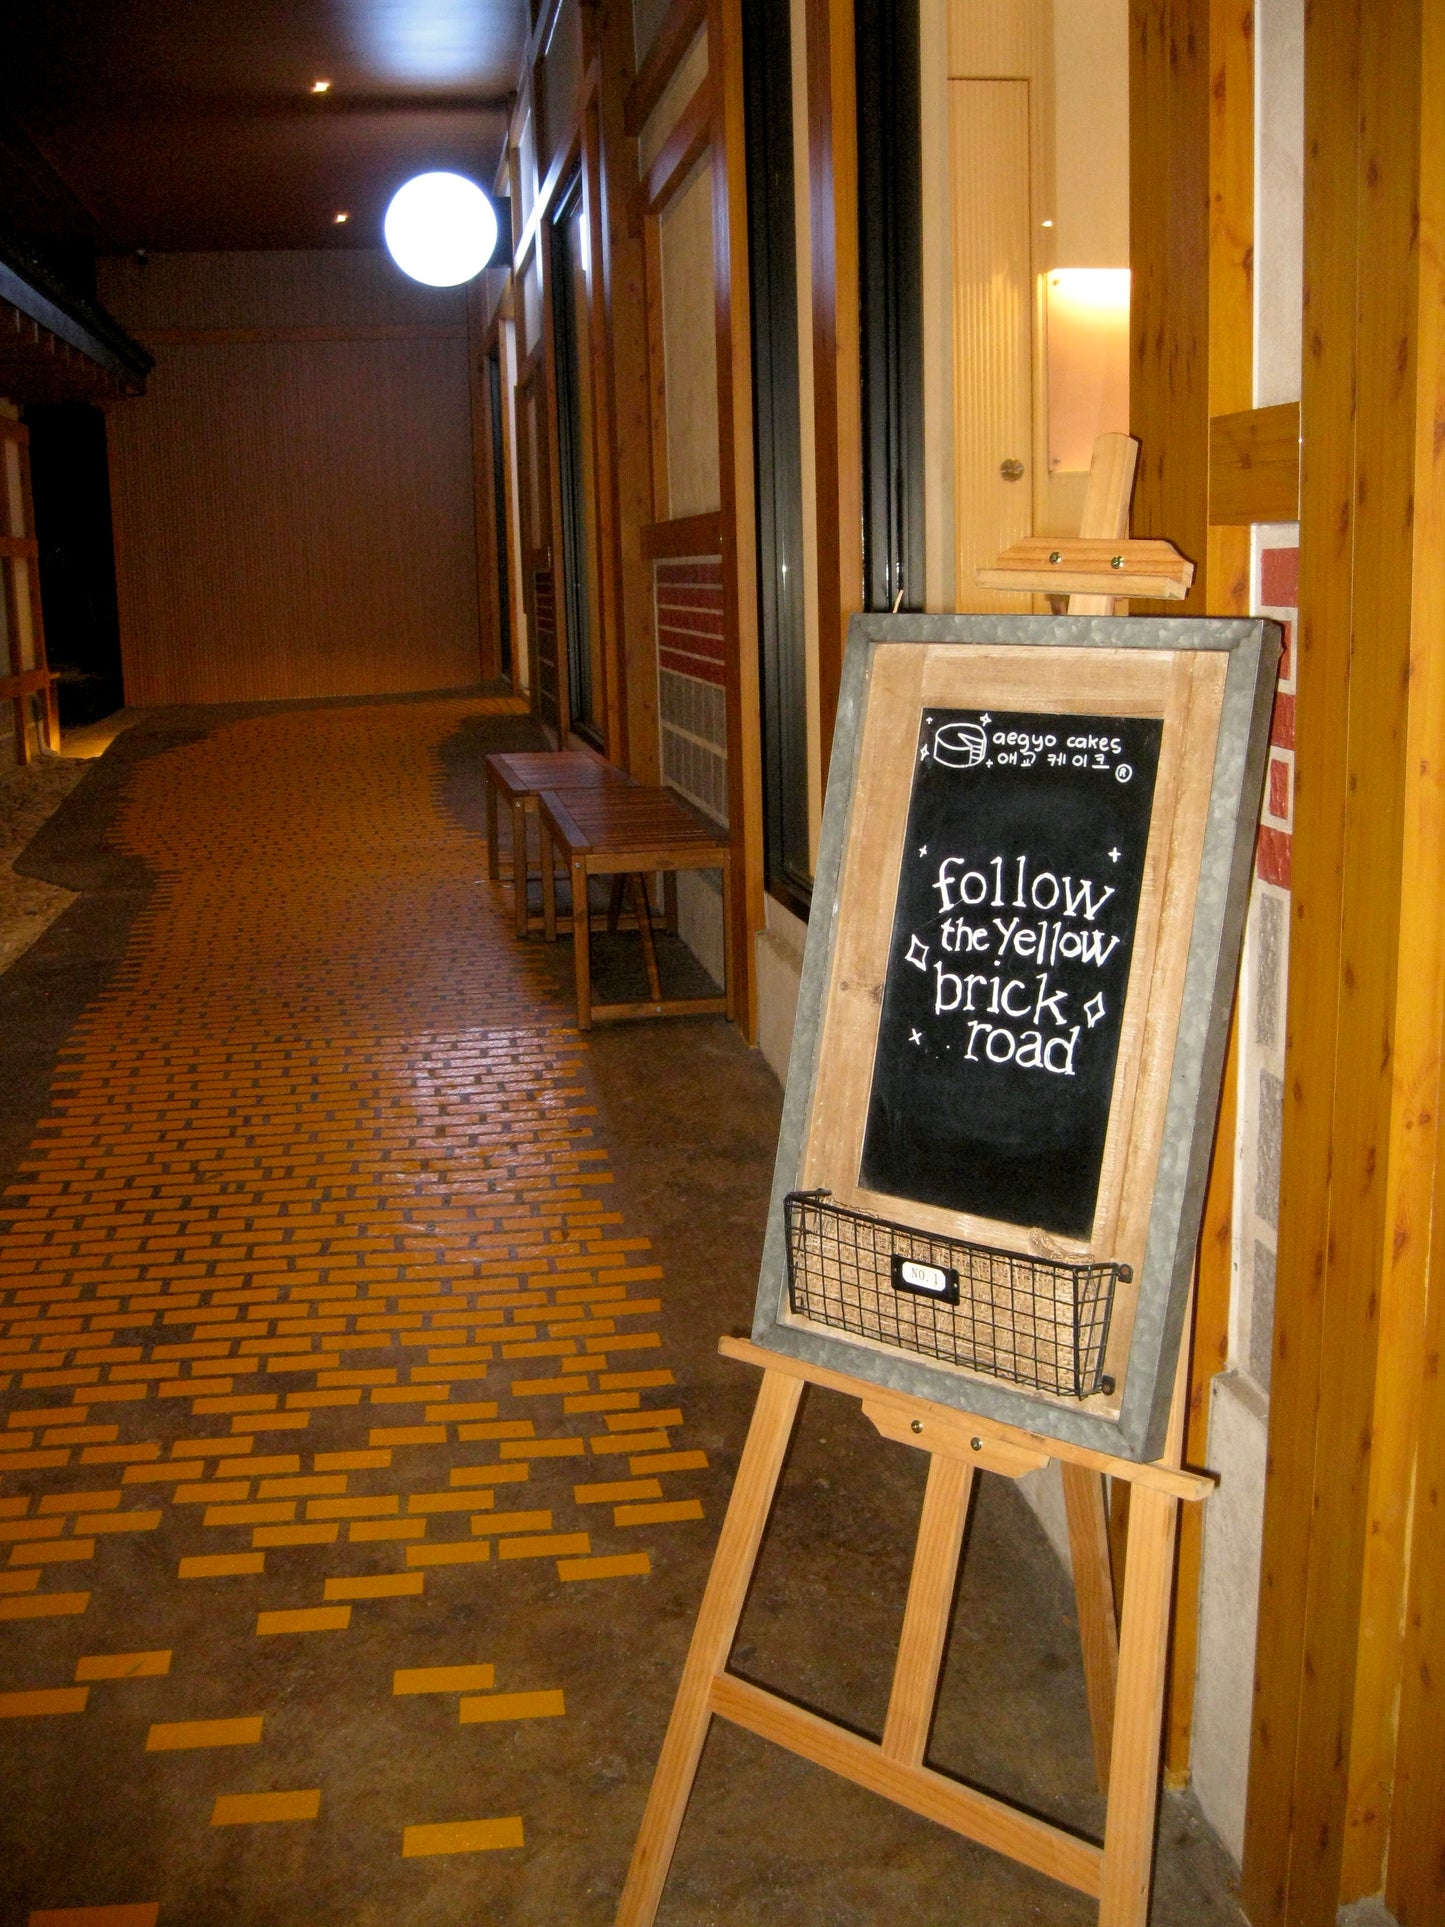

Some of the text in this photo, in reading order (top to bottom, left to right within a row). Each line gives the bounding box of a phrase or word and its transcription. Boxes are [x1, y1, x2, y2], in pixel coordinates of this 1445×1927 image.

[992, 731, 1122, 754] aegyo cakes
[1047, 752, 1110, 769] 케이크
[932, 855, 1115, 920] follow
[940, 917, 990, 952] the
[934, 959, 1068, 1025] brick
[964, 1019, 1081, 1075] road
